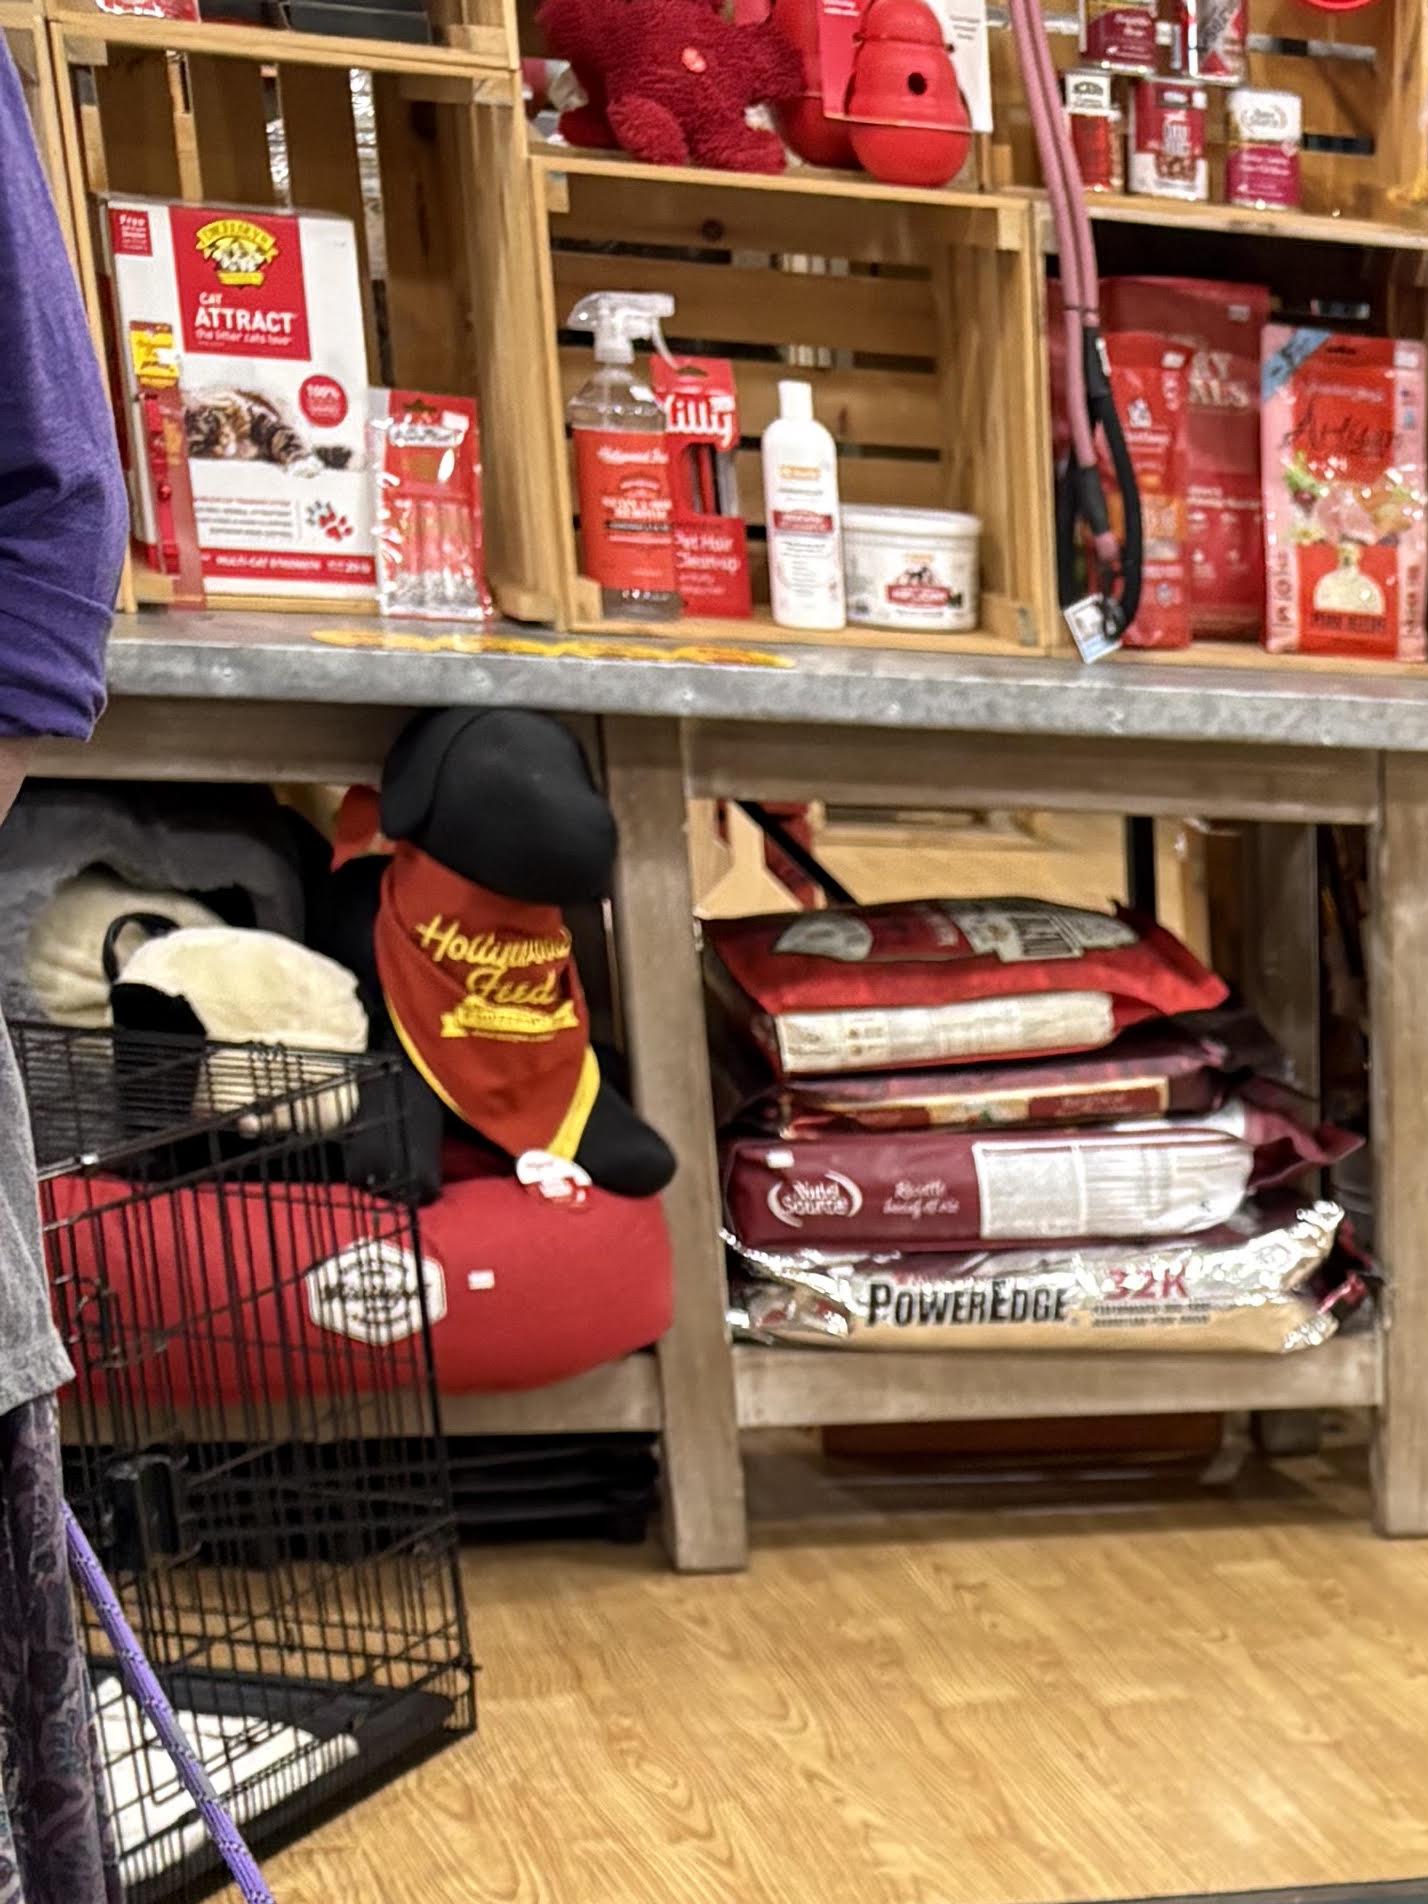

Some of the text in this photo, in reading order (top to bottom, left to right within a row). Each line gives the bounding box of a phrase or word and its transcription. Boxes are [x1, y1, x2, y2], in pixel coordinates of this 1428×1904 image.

[195, 307, 292, 334] ATTRACT
[416, 913, 572, 970] Hollywood
[466, 968, 560, 1006] Feed
[1104, 1267, 1190, 1299] 32K
